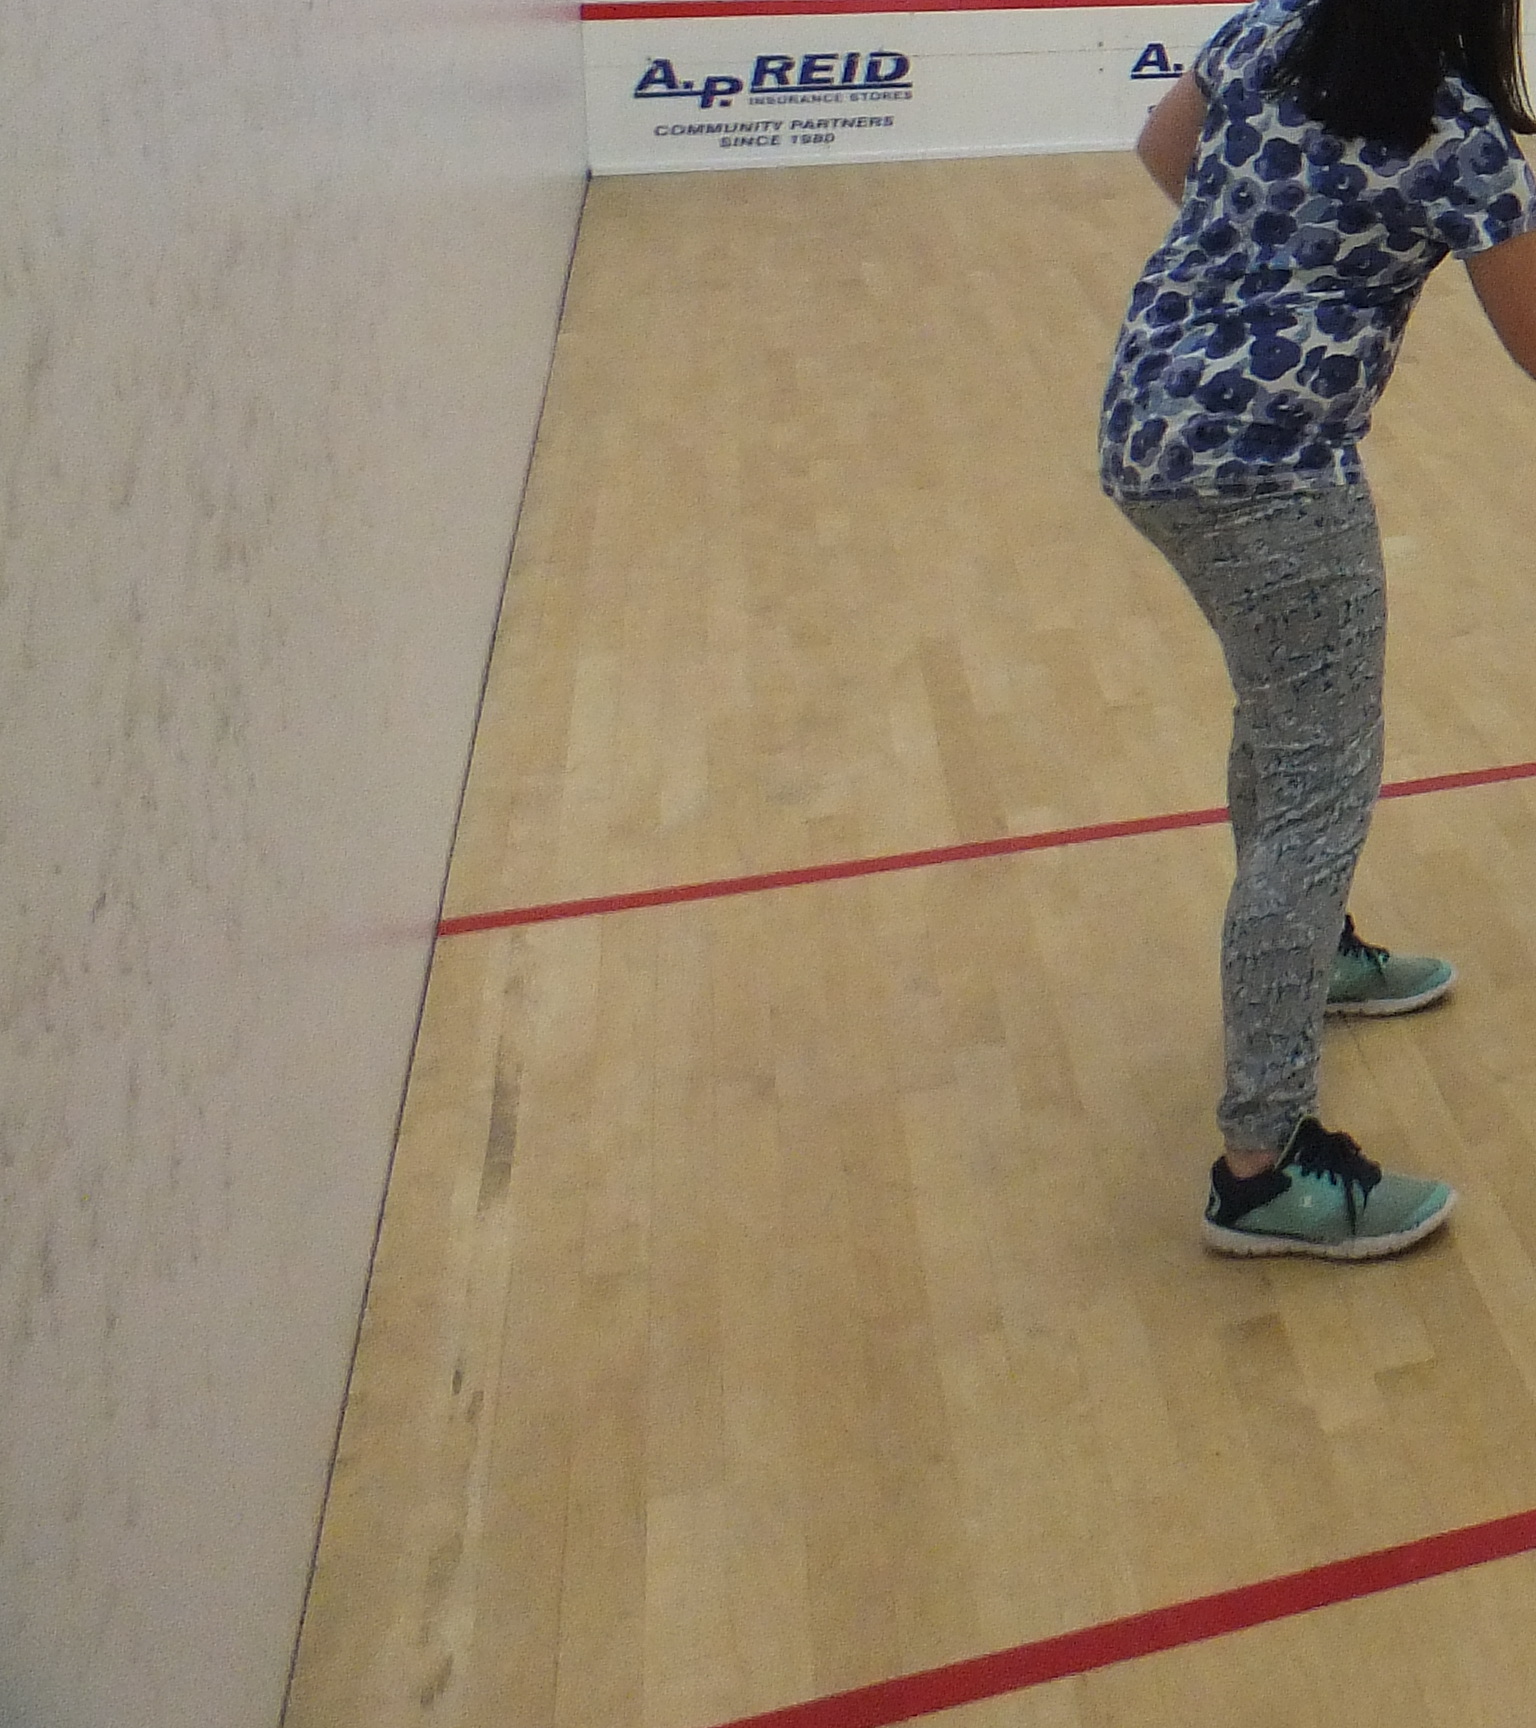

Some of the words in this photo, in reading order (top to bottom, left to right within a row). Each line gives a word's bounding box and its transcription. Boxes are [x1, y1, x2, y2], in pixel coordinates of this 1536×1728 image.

[750, 50, 912, 92] REID
[749, 91, 842, 106] INSURANCE
[849, 90, 913, 103] STORES
[653, 120, 784, 137] COMMUNITY
[790, 115, 895, 131] PARTNERS
[719, 134, 782, 148] SINCE
[791, 132, 836, 145] 1980
